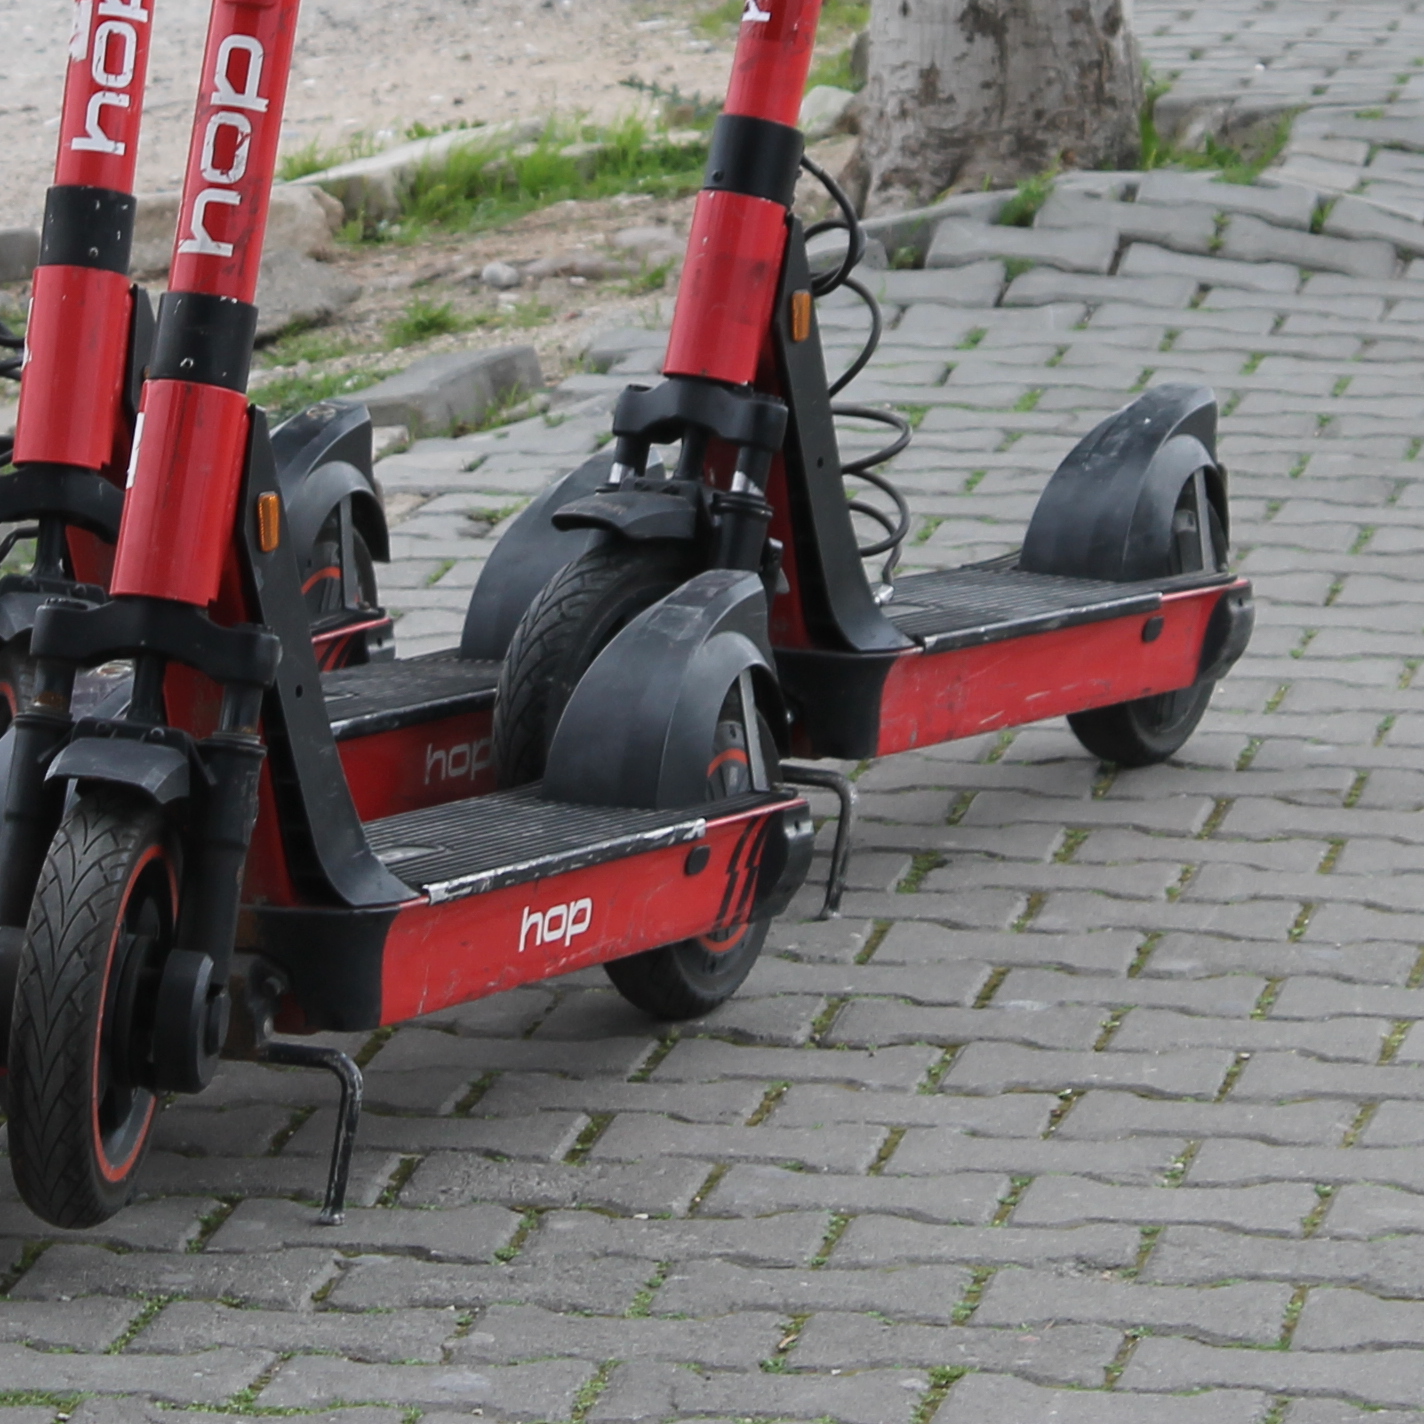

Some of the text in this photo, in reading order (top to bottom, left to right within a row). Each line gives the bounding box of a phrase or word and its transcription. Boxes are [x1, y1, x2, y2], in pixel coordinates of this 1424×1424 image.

[177, 34, 270, 258] hop
[423, 737, 496, 785] hop
[518, 897, 593, 953] hop
